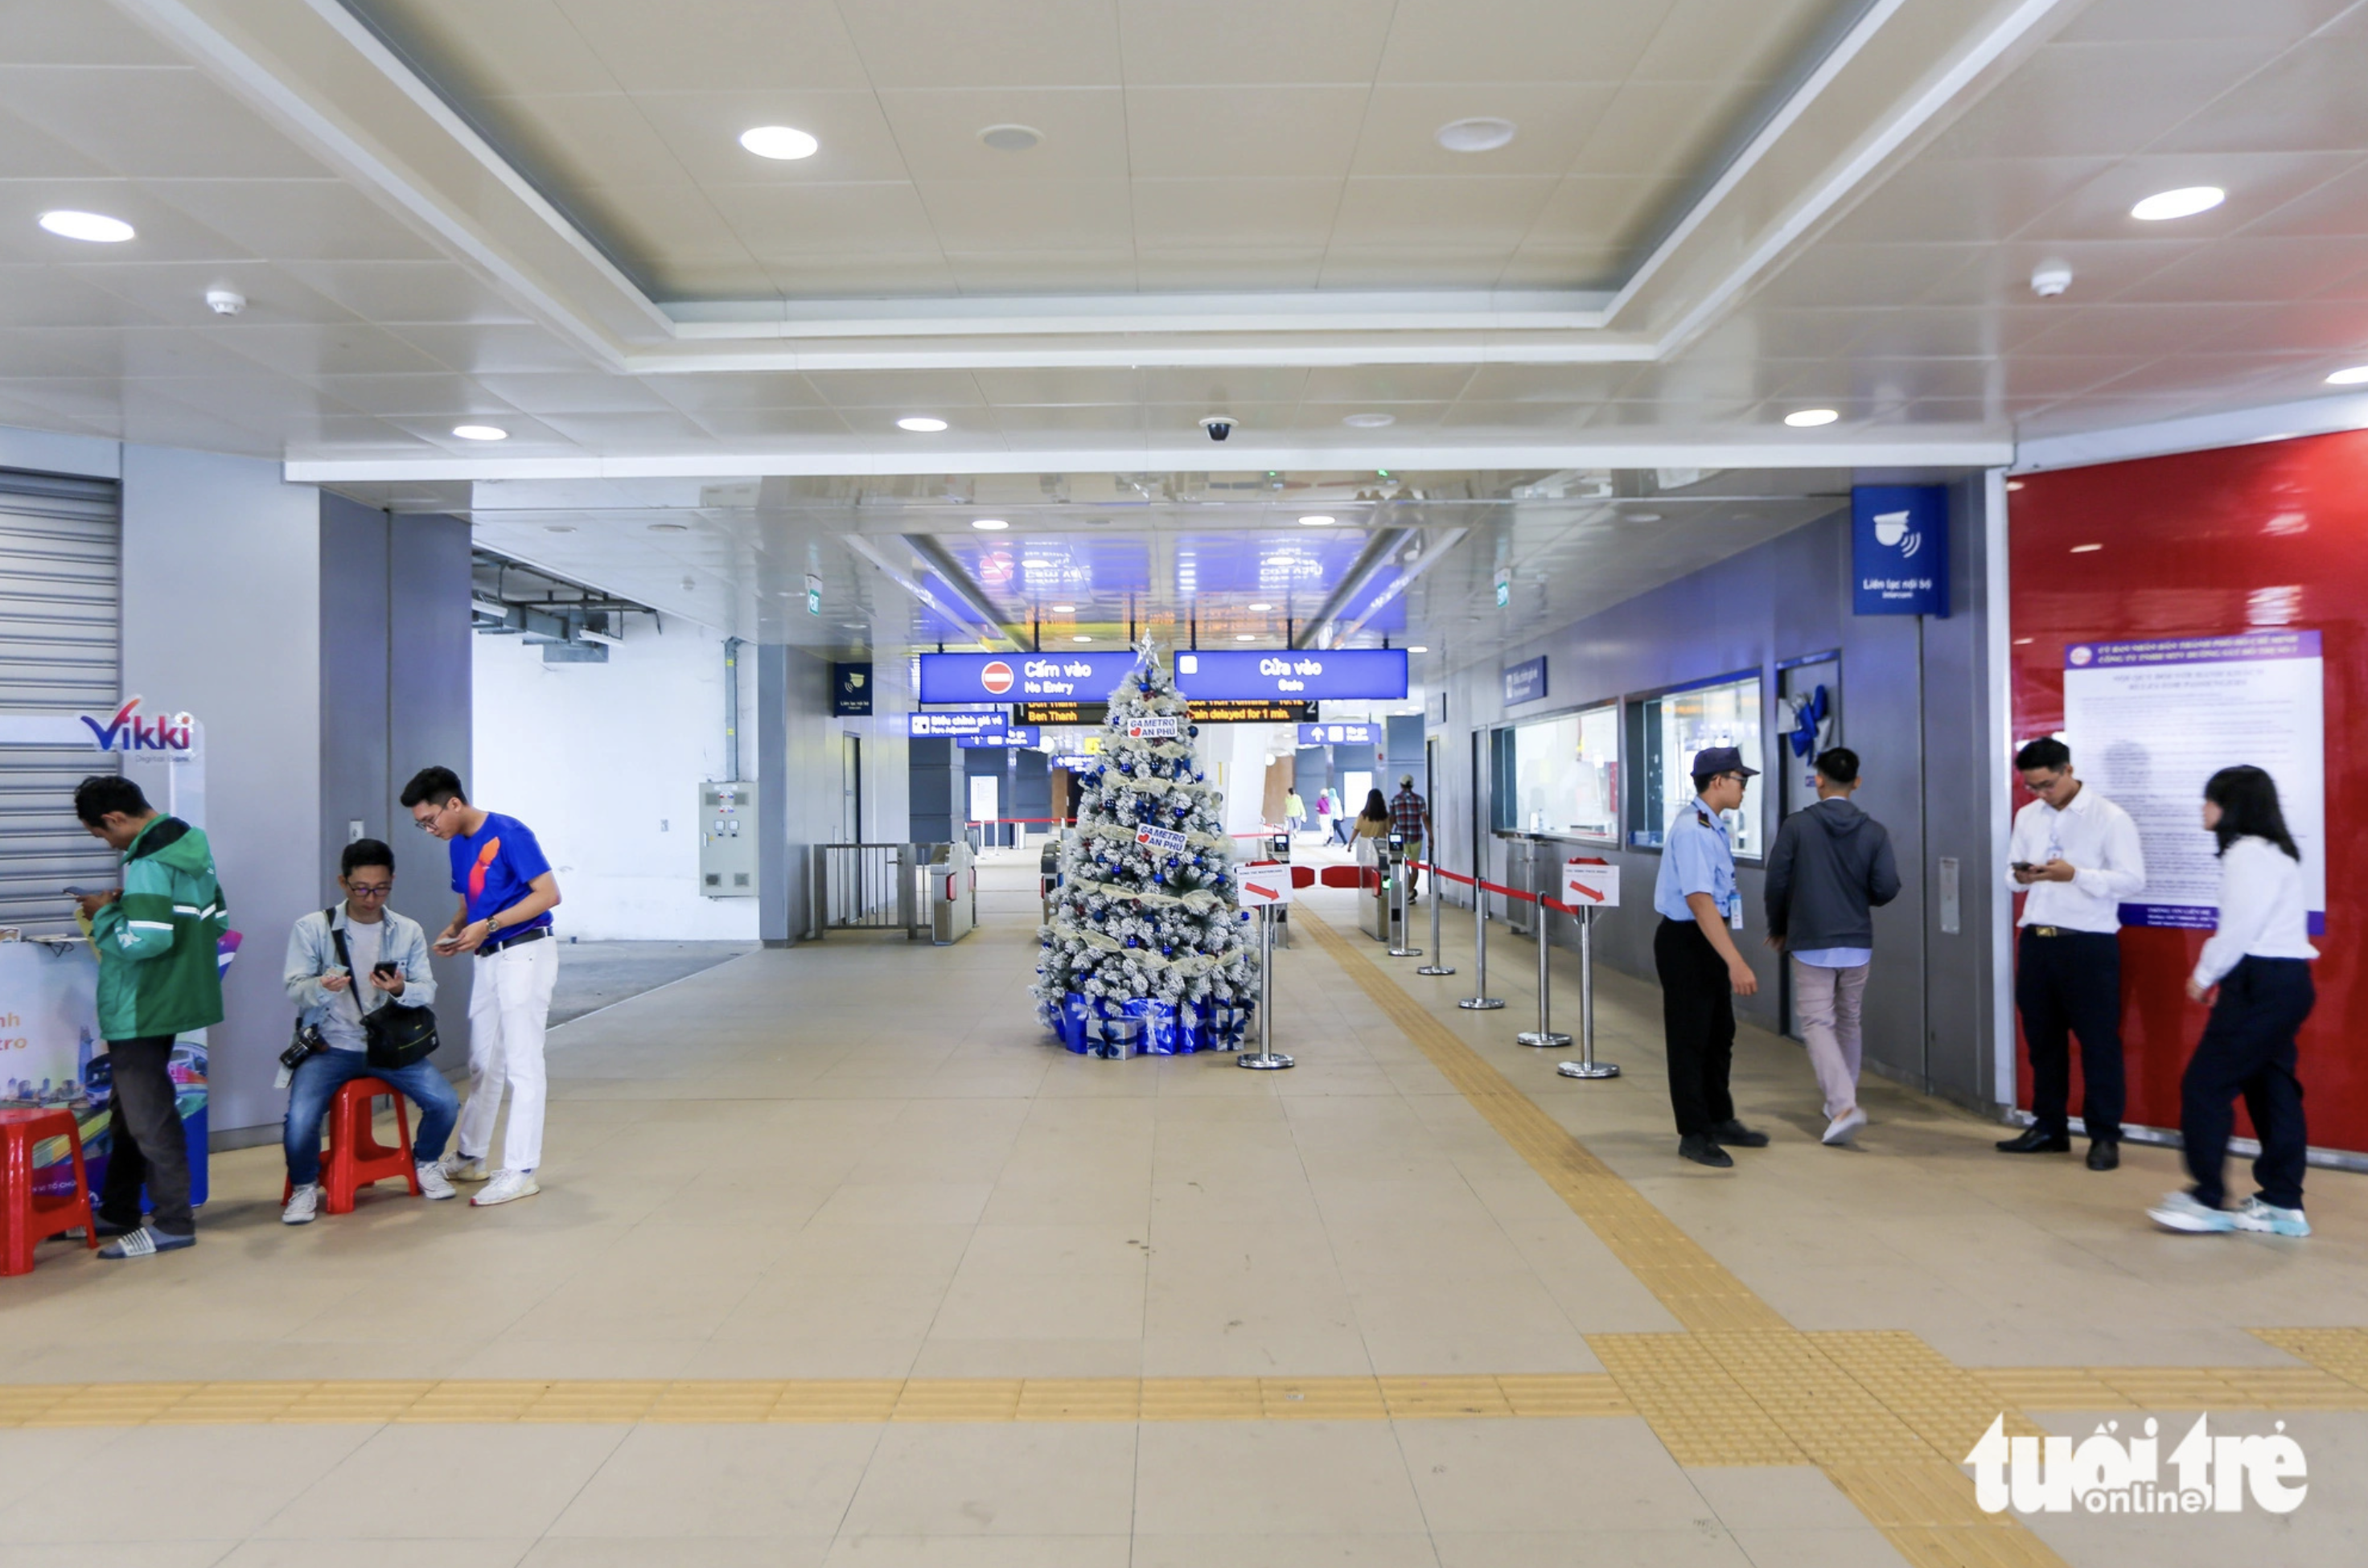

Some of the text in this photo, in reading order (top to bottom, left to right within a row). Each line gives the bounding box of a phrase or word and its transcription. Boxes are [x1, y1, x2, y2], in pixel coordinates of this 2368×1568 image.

[1024, 659, 1092, 678] Cấm vào
[1260, 657, 1322, 676] Cửa vào
[1024, 680, 1074, 696] No Entry
[1277, 678, 1304, 692] Gate
[1027, 710, 1078, 722] Ben Thanh
[1209, 708, 1246, 721] delayed
[1247, 708, 1261, 720] for
[1261, 708, 1268, 720] 1
[1270, 708, 1290, 720] min.
[80, 698, 190, 750] Vikki
[1143, 718, 1175, 727] METRO
[1142, 728, 1154, 736] AN
[1141, 826, 1186, 843] GA METRO
[1148, 837, 1162, 847] AN
